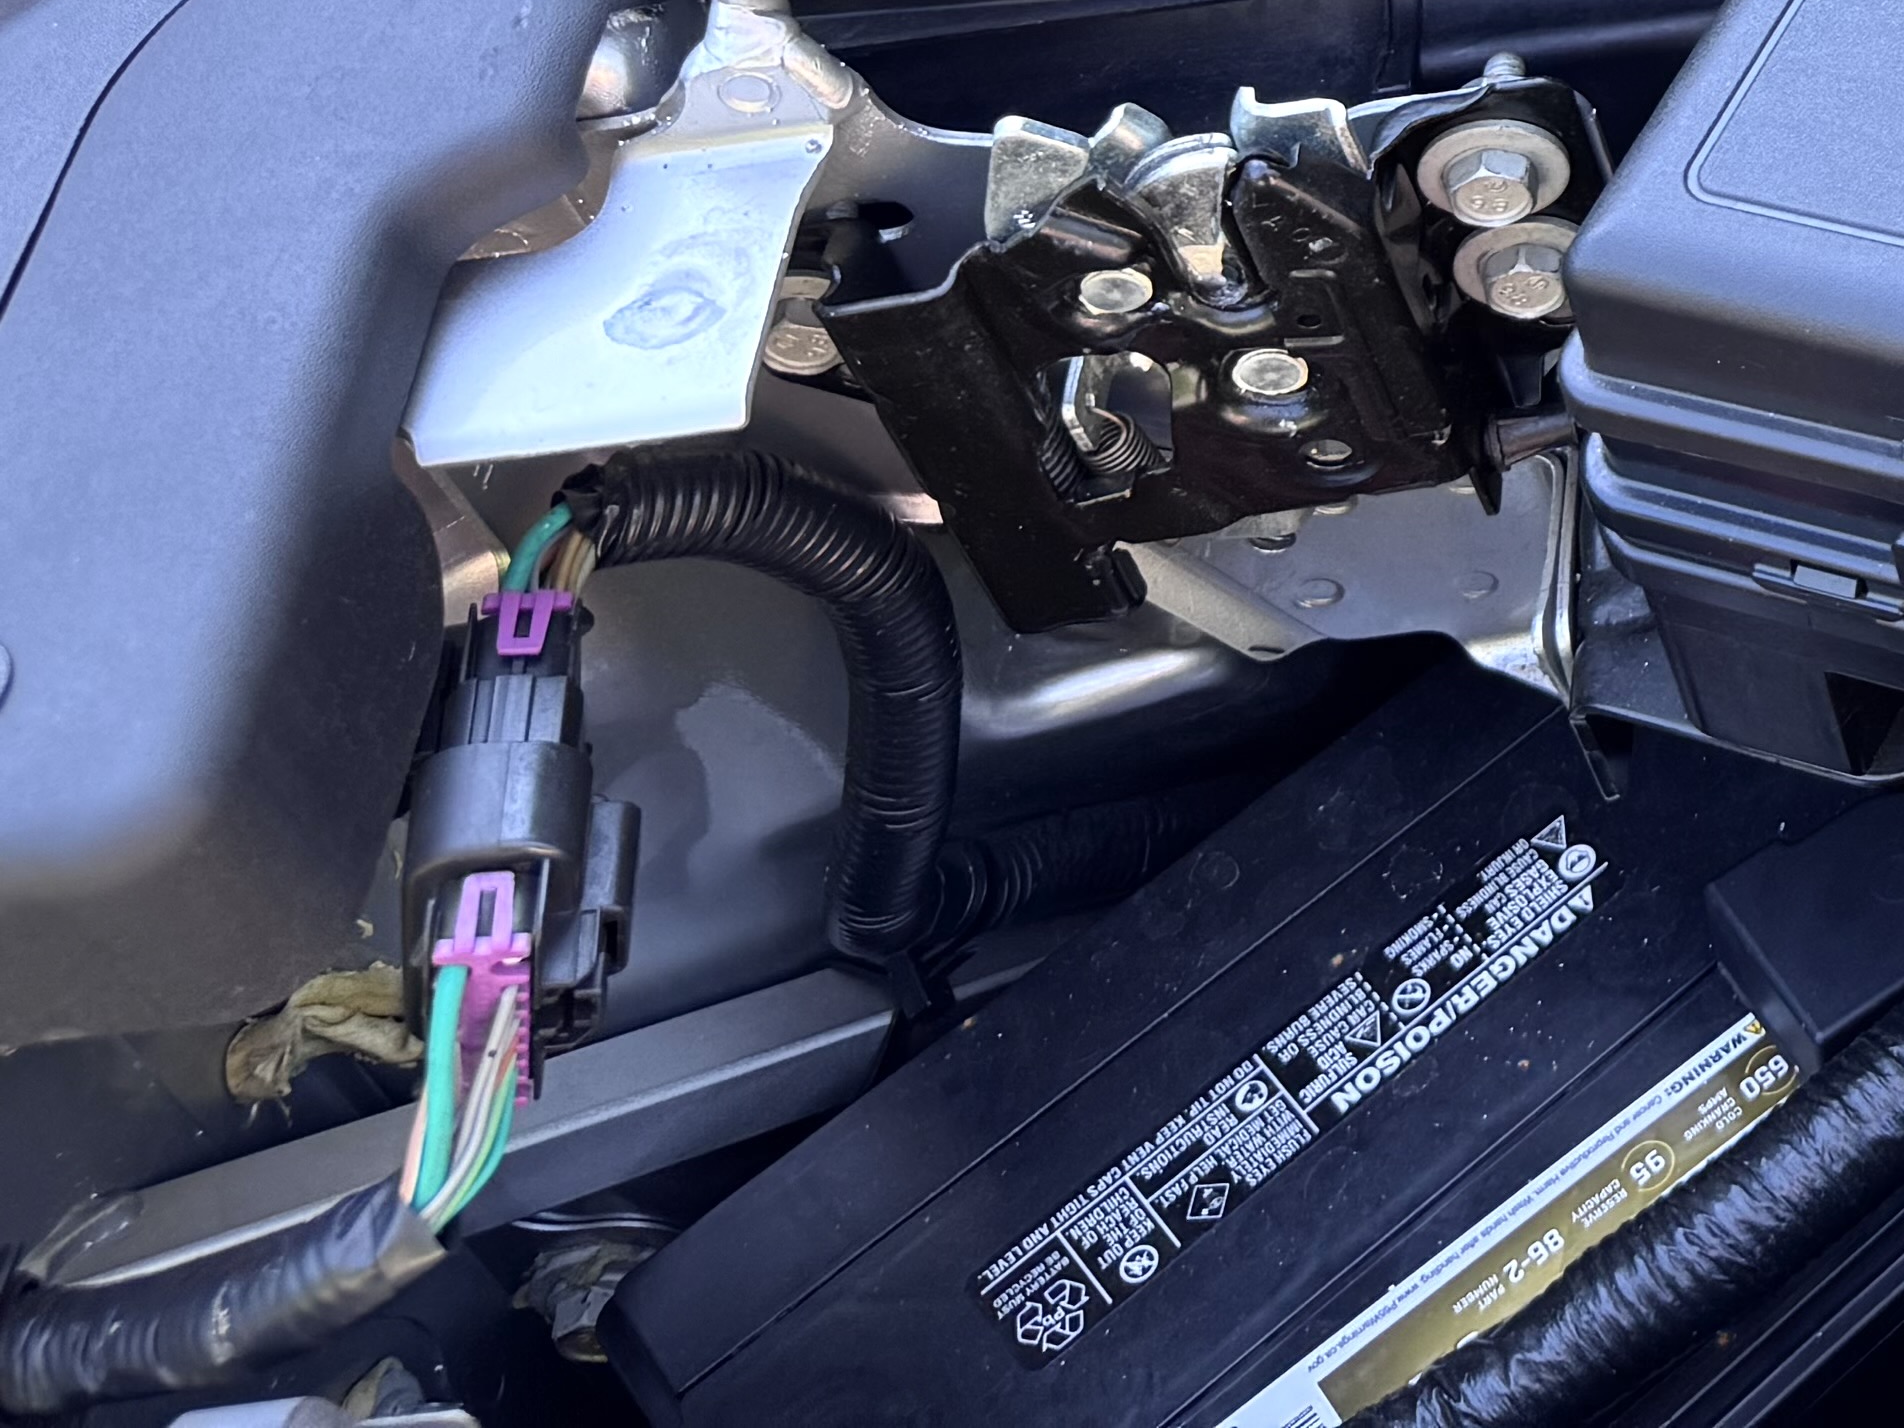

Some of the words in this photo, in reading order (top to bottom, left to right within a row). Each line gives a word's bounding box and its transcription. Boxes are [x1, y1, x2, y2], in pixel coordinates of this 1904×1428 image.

[1504, 846, 1540, 879] CAUSE
[1509, 836, 1530, 856] OR
[1502, 856, 1549, 899] GASES
[1453, 870, 1510, 920] BLINDNESS
[1482, 890, 1508, 915] CAN
[1485, 867, 1559, 932] EXPLOSIVE
[1519, 877, 1569, 922] SHIELD
[1381, 913, 1435, 961] SMOKING
[1398, 926, 1445, 967] FLAMES
[1408, 937, 1456, 979] SPARKS
[1447, 944, 1474, 970] NO
[1306, 974, 1358, 1021] SEVERE
[1328, 902, 1579, 1114] DANGER/POISON
[1344, 997, 1377, 1027] CAN
[1295, 986, 1367, 1048] BLINDNESS
[1275, 1041, 1300, 1065] OR
[1304, 1018, 1351, 1059] CAUSE
[1313, 1039, 1348, 1071] ACID
[1230, 1058, 1254, 1081] DO
[1296, 1049, 1358, 1105] SULFURIC
[1662, 1029, 1747, 1100] WARNING:
[1735, 1051, 1792, 1102] 650
[1205, 1073, 1236, 1101] NOT
[1695, 1085, 1729, 1115] AMPS
[1259, 1097, 1287, 1123] GET
[1261, 1107, 1295, 1138] WITH
[1629, 1092, 1663, 1123] Cancer
[1681, 1095, 1737, 1142] CRANKING
[1713, 1104, 1744, 1131] COLD
[1150, 1113, 1186, 1146] KEEP
[1200, 1111, 1239, 1147] READ
[1212, 1114, 1265, 1161] MEDICAL
[1612, 1117, 1632, 1136] and
[1118, 1138, 1155, 1172] VENT
[1226, 1117, 1303, 1183] IMMEDIATELY
[1271, 1126, 1313, 1164] FLUSH
[1556, 1128, 1616, 1178] Reproductive
[1084, 1164, 1123, 1199] CAPS
[1183, 1153, 1218, 1185] HELP
[1243, 1156, 1277, 1188] EYES
[1626, 1147, 1668, 1186] 95
[1047, 1191, 1089, 1228] TIGHT
[1063, 1184, 1130, 1242] CHILDREN.
[1094, 1195, 1138, 1235] REACH
[1505, 1193, 1534, 1218] Wash
[1566, 1176, 1622, 1223] CAPACITY
[1578, 1186, 1629, 1229] RESERVE
[1101, 1219, 1130, 1247] THE
[1119, 1216, 1155, 1249] KEEP
[1123, 1206, 1147, 1228] OF
[1478, 1213, 1509, 1239] hands
[1019, 1221, 1052, 1251] AND
[1076, 1228, 1098, 1249] OF
[1457, 1234, 1481, 1256] after
[975, 1243, 1024, 1286] LEVEL.
[1043, 1249, 1061, 1266] BE
[1094, 1241, 1125, 1270] OUT
[1499, 1226, 1567, 1285] 86-2
[990, 1261, 1046, 1309] RECYCLED
[1022, 1254, 1070, 1296] BATTERY
[993, 1291, 1025, 1320] MUST
[1449, 1272, 1500, 1314] NUMBER
[1474, 1282, 1507, 1312] PART
[1039, 1304, 1067, 1330] Pb
